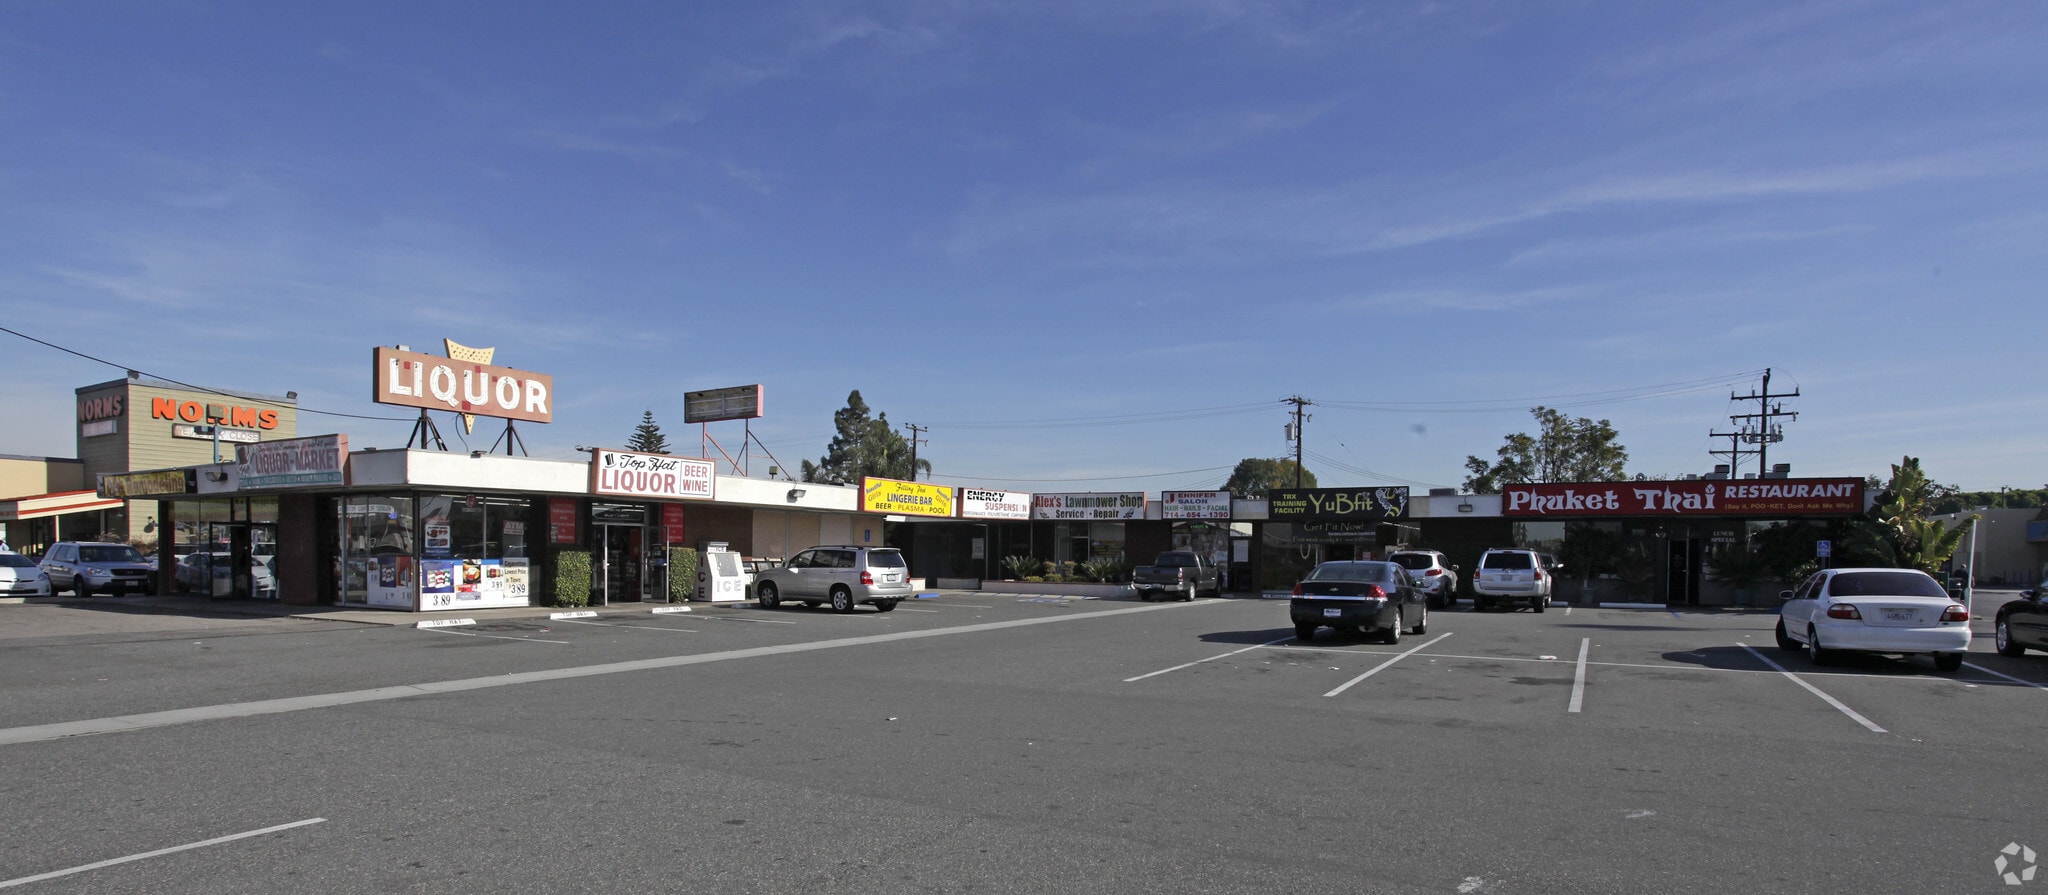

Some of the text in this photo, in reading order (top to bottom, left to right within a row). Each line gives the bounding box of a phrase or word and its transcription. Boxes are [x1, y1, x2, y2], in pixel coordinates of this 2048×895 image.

[390, 358, 548, 414] LIQUOR
[78, 395, 121, 421] NORMS
[229, 431, 259, 441] CLOSE
[620, 454, 679, 471] Top Hat
[684, 464, 708, 478] BEER
[601, 468, 676, 493] LIQUOR
[682, 479, 708, 492] WINE
[967, 490, 1005, 502] ENERGY
[1725, 484, 1856, 499] RESTAURANT
[886, 493, 933, 505] LINGERIE BAR
[1035, 494, 1143, 508] Alex's Lawnmower Shop
[1508, 484, 1716, 514] Phuket Thai
[897, 504, 925, 512] PLASMA
[1055, 508, 1119, 519] Service Repair
[505, 521, 524, 530] ATM
[1340, 522, 1364, 531] Now!
[504, 567, 517, 575] Lowest
[716, 579, 742, 593] ICE
